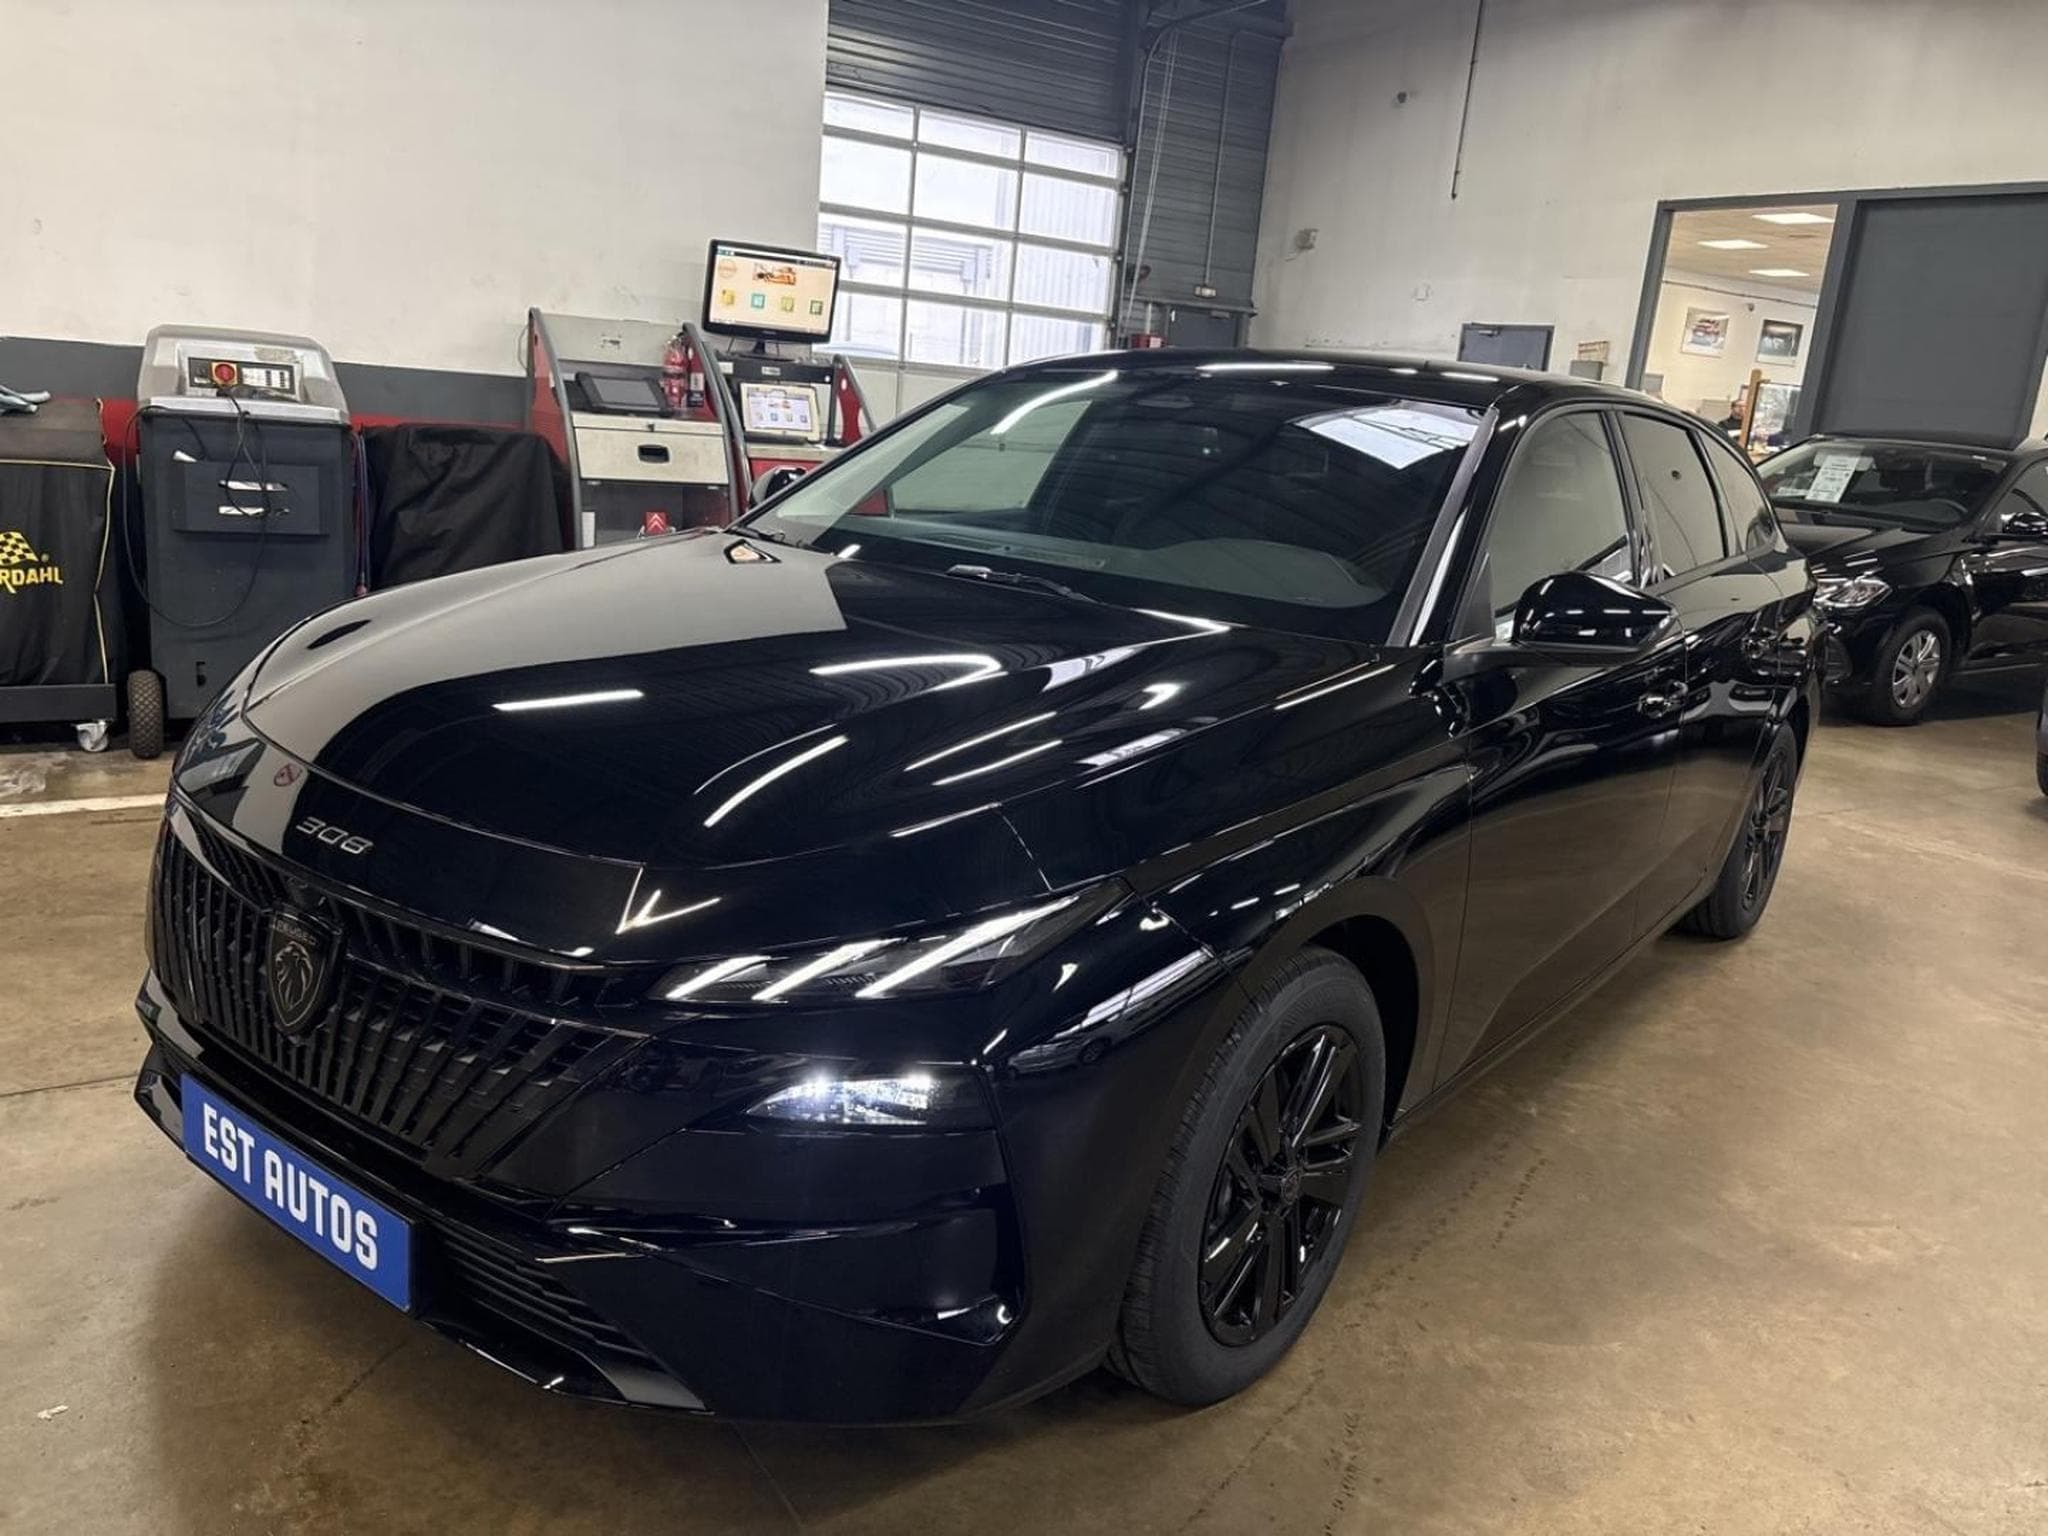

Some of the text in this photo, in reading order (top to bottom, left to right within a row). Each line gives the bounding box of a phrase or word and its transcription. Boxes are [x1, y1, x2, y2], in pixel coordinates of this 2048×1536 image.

[296, 816, 374, 854] 308
[203, 1103, 379, 1272] EST AUTOS
